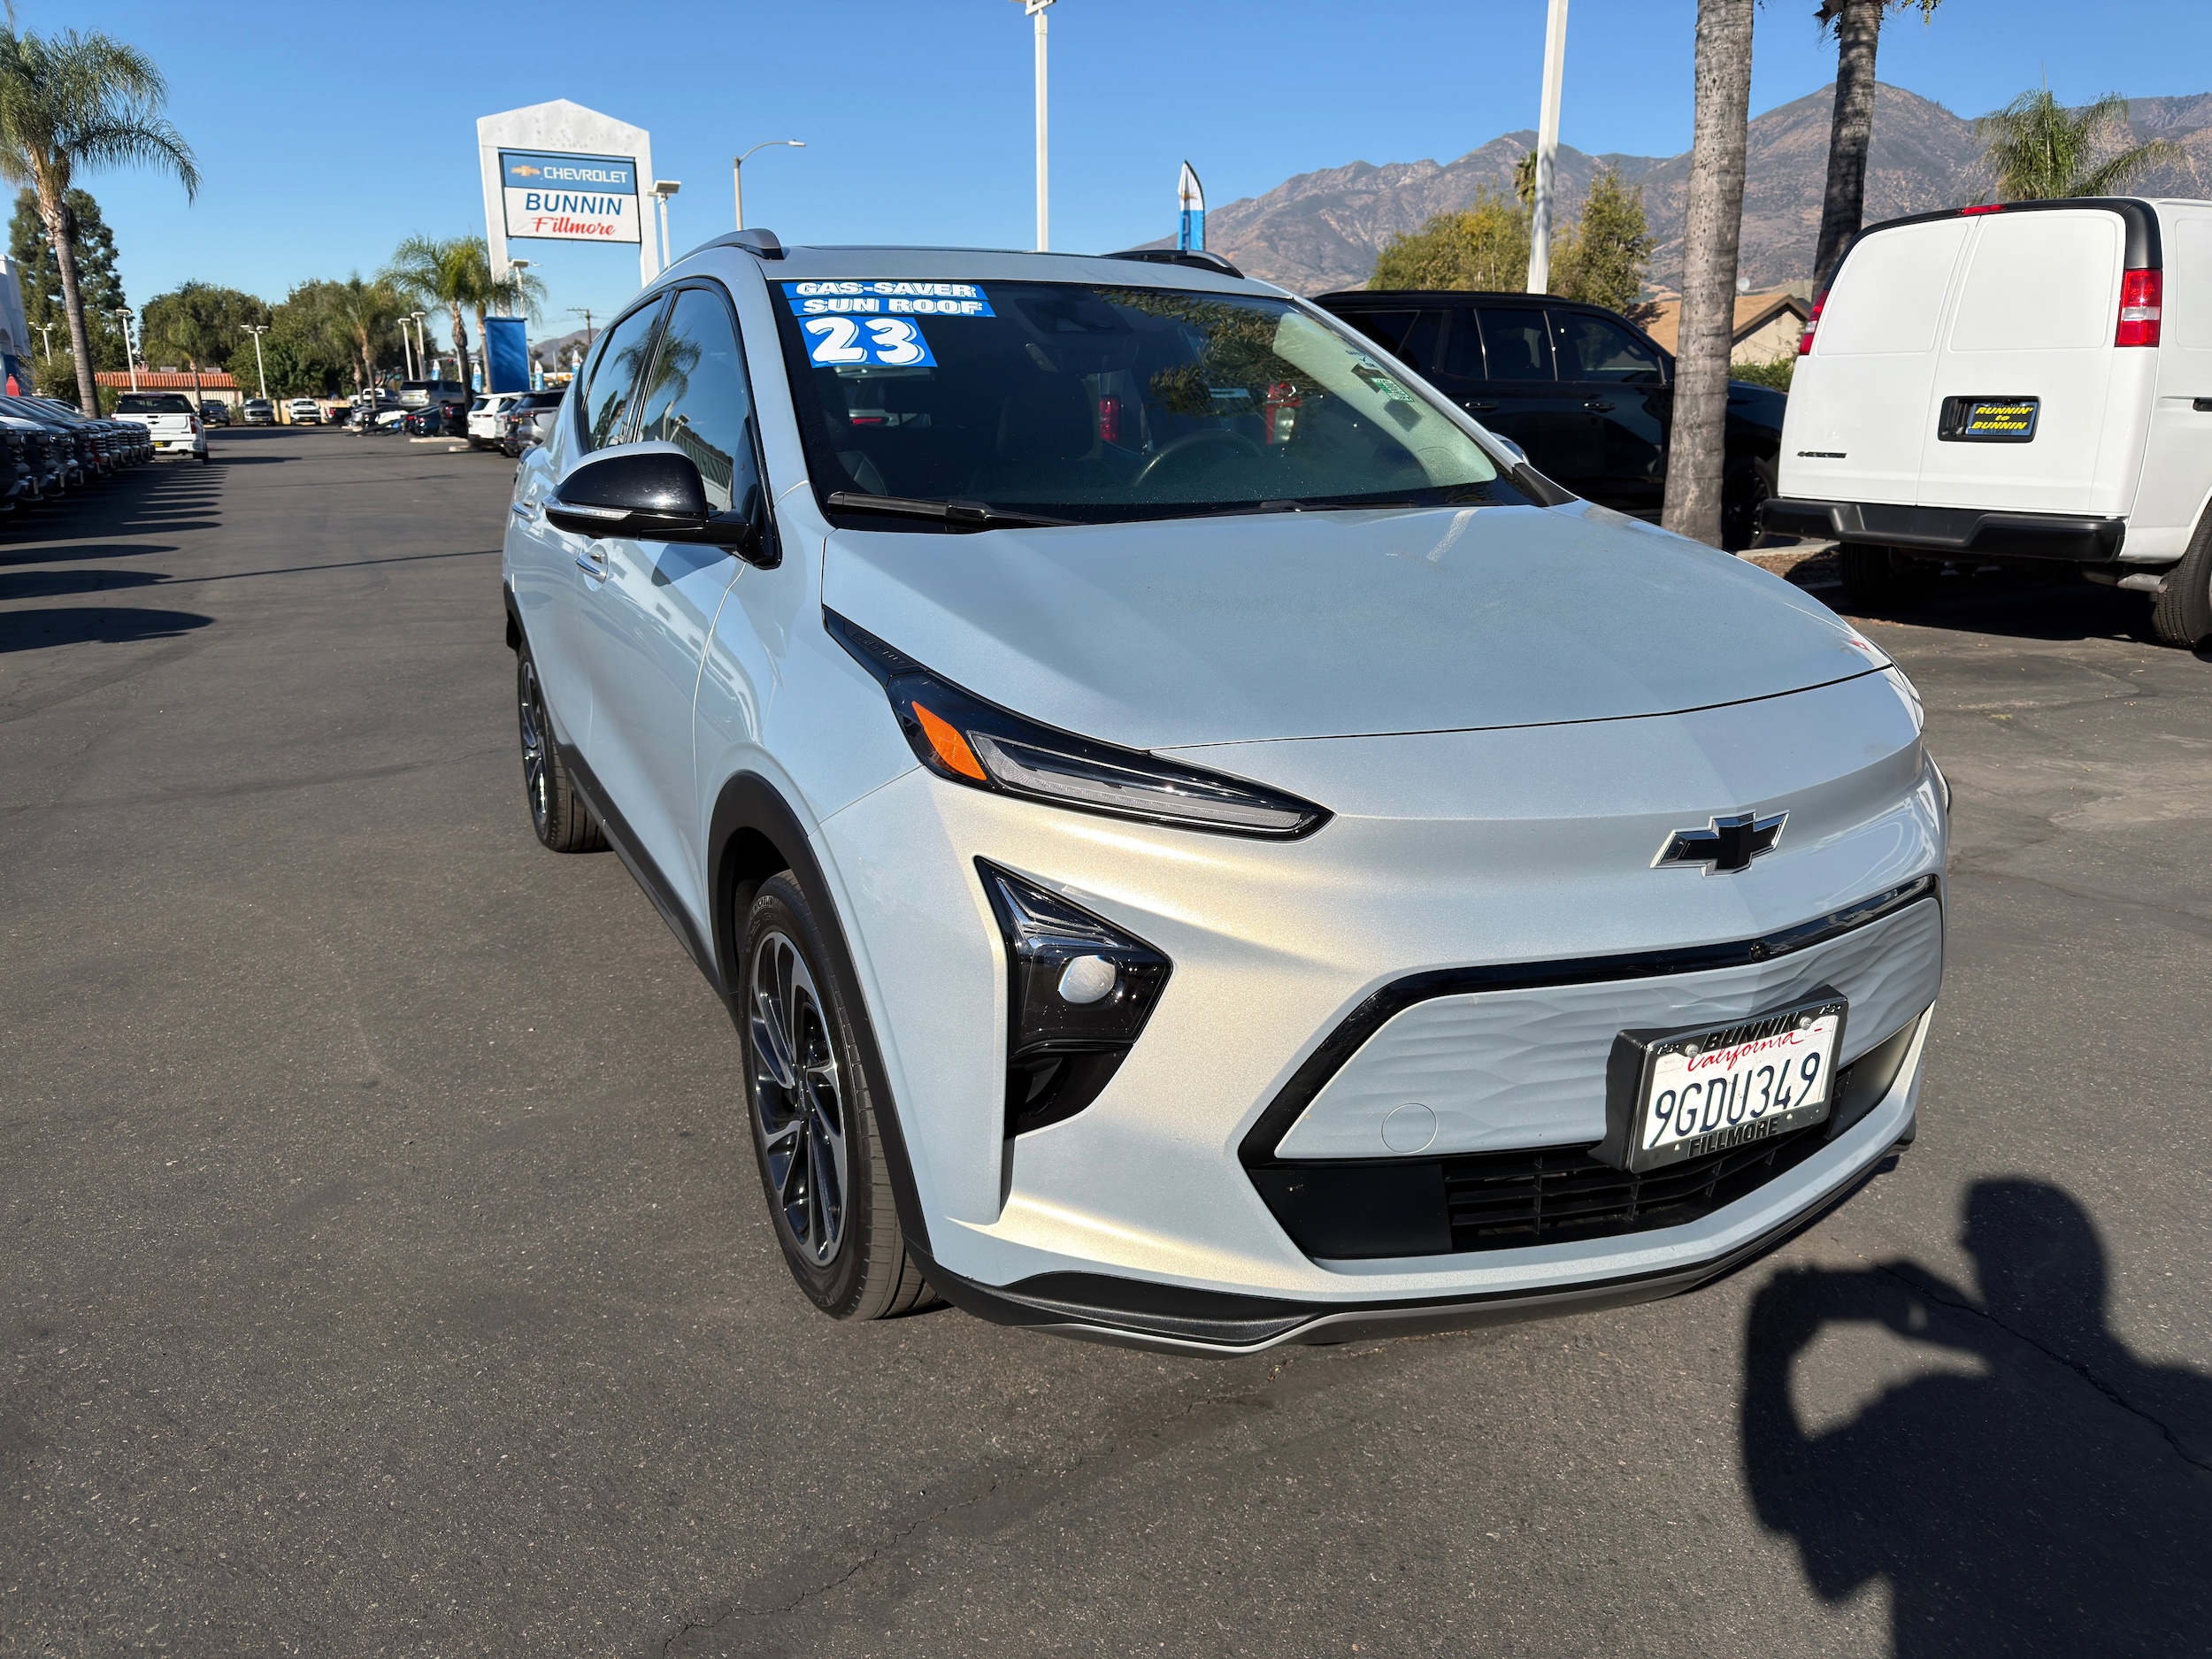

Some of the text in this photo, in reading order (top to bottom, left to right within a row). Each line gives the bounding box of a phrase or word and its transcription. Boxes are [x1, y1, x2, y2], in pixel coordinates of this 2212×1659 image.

[543, 166, 627, 183] CHEVROLET
[525, 193, 622, 216] BUNNIN
[530, 217, 617, 236] Fillmore
[795, 281, 978, 298] GAS-SAVER
[803, 298, 983, 315] SUN ROOF
[805, 317, 926, 365] 23
[1971, 421, 2028, 430] BUNNIN
[1700, 1011, 1799, 1053] BUNNIN
[1686, 1030, 1805, 1072] California
[1649, 1051, 1821, 1148] 9GDU349
[1687, 1117, 1779, 1157] FILLMORE
